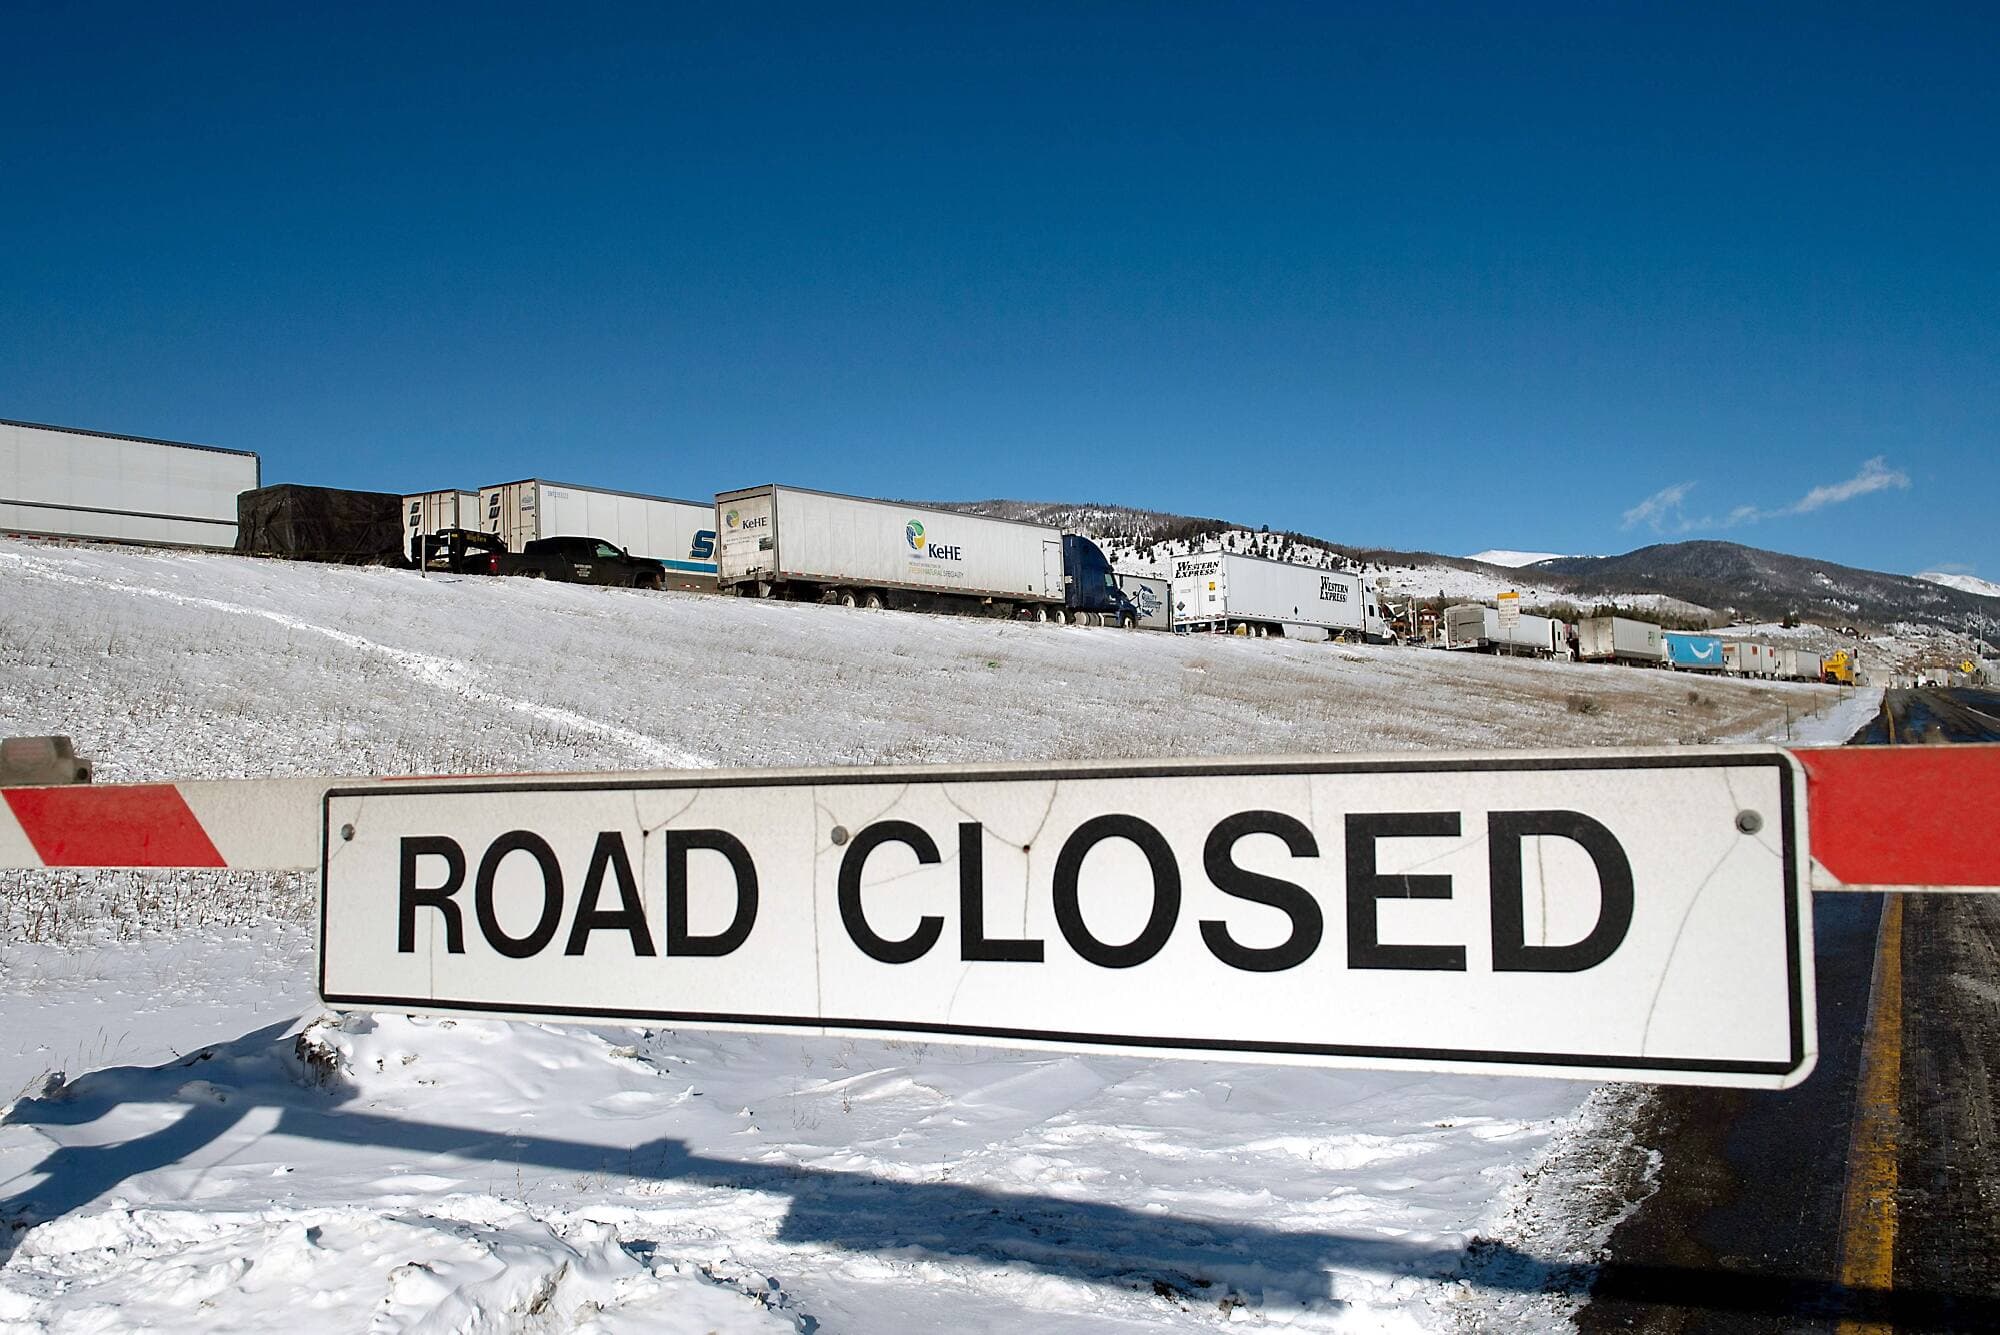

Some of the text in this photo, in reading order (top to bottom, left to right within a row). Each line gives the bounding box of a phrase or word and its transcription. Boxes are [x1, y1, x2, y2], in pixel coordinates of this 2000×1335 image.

[742, 516, 768, 529] KeHE
[928, 543, 962, 561] KeHE
[1177, 561, 1219, 571] WESTERN
[1320, 575, 1348, 593] WESTERN
[399, 811, 1634, 973] ROAD CLOSED
